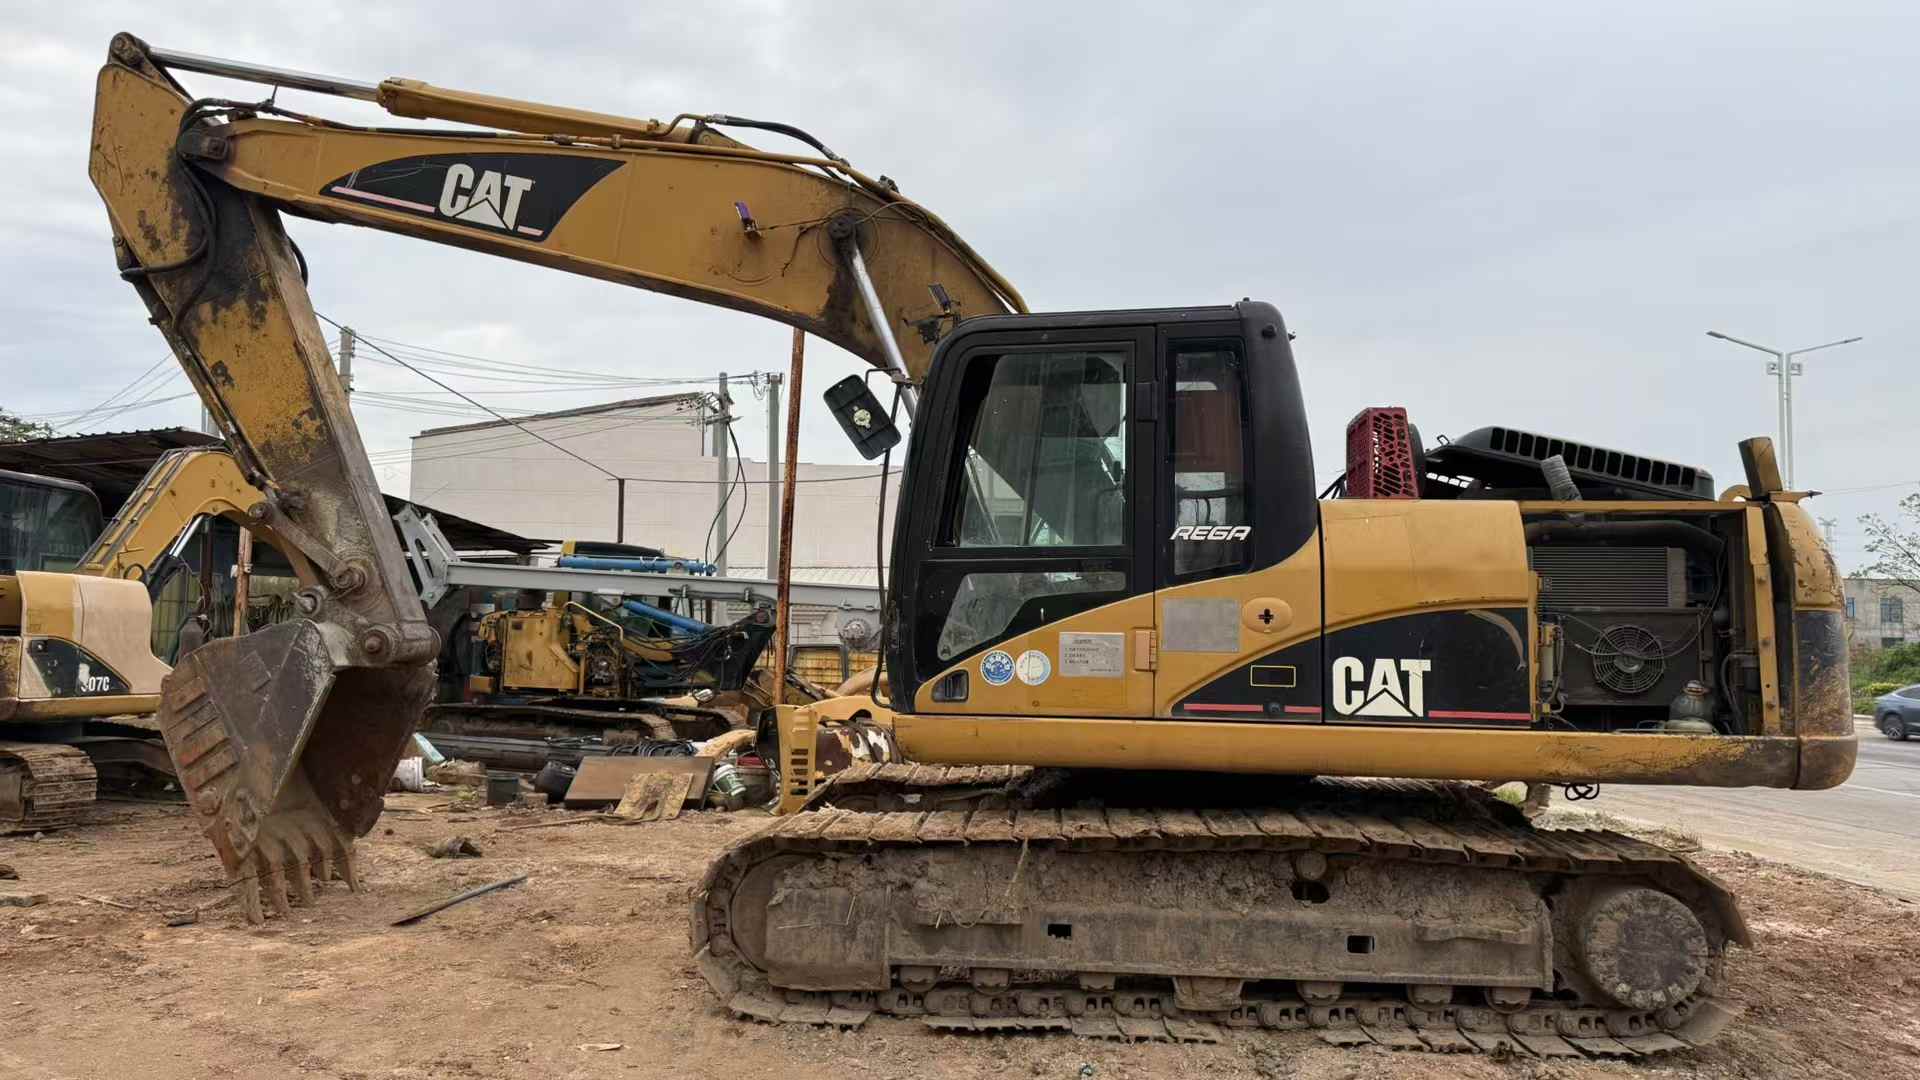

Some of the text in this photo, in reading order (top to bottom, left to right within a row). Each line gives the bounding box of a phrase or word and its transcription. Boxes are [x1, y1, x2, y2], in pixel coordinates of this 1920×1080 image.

[439, 163, 533, 231] CAT
[1169, 525, 1252, 541] REGA
[1332, 656, 1431, 717] CAT
